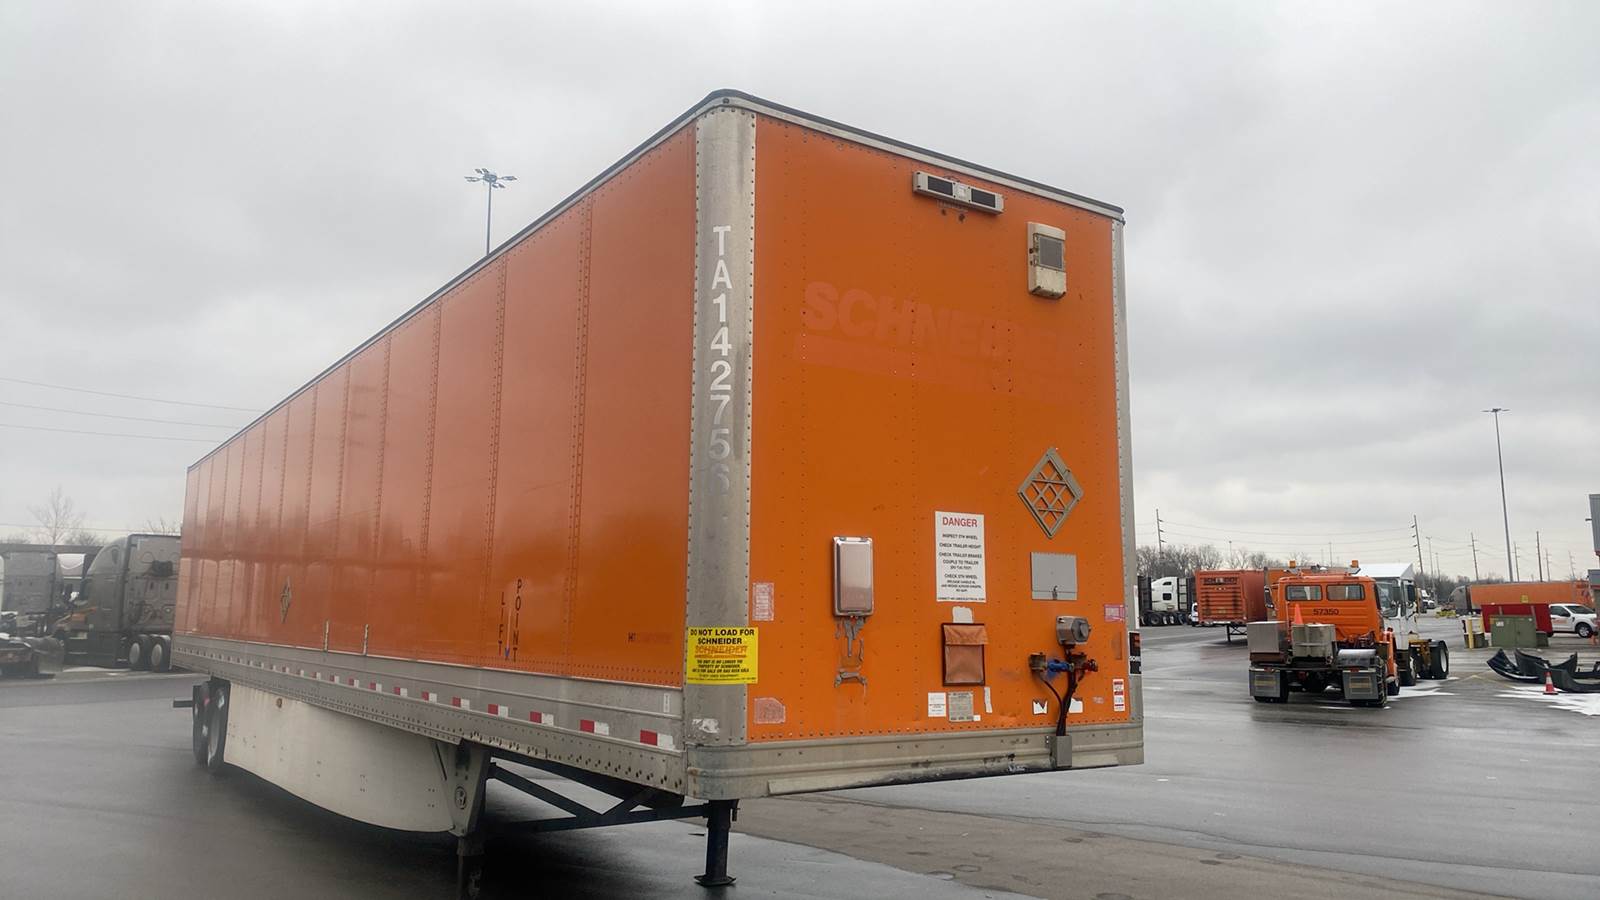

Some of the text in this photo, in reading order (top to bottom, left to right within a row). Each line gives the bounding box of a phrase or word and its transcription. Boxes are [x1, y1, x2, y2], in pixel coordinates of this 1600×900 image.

[942, 516, 978, 528] DANGER
[1313, 608, 1339, 616] 57350
[498, 591, 506, 656] LIFT
[512, 578, 522, 662] POINT
[690, 628, 755, 636] DO NOT LOAD FOR
[697, 637, 743, 645] SCHNEIDER
